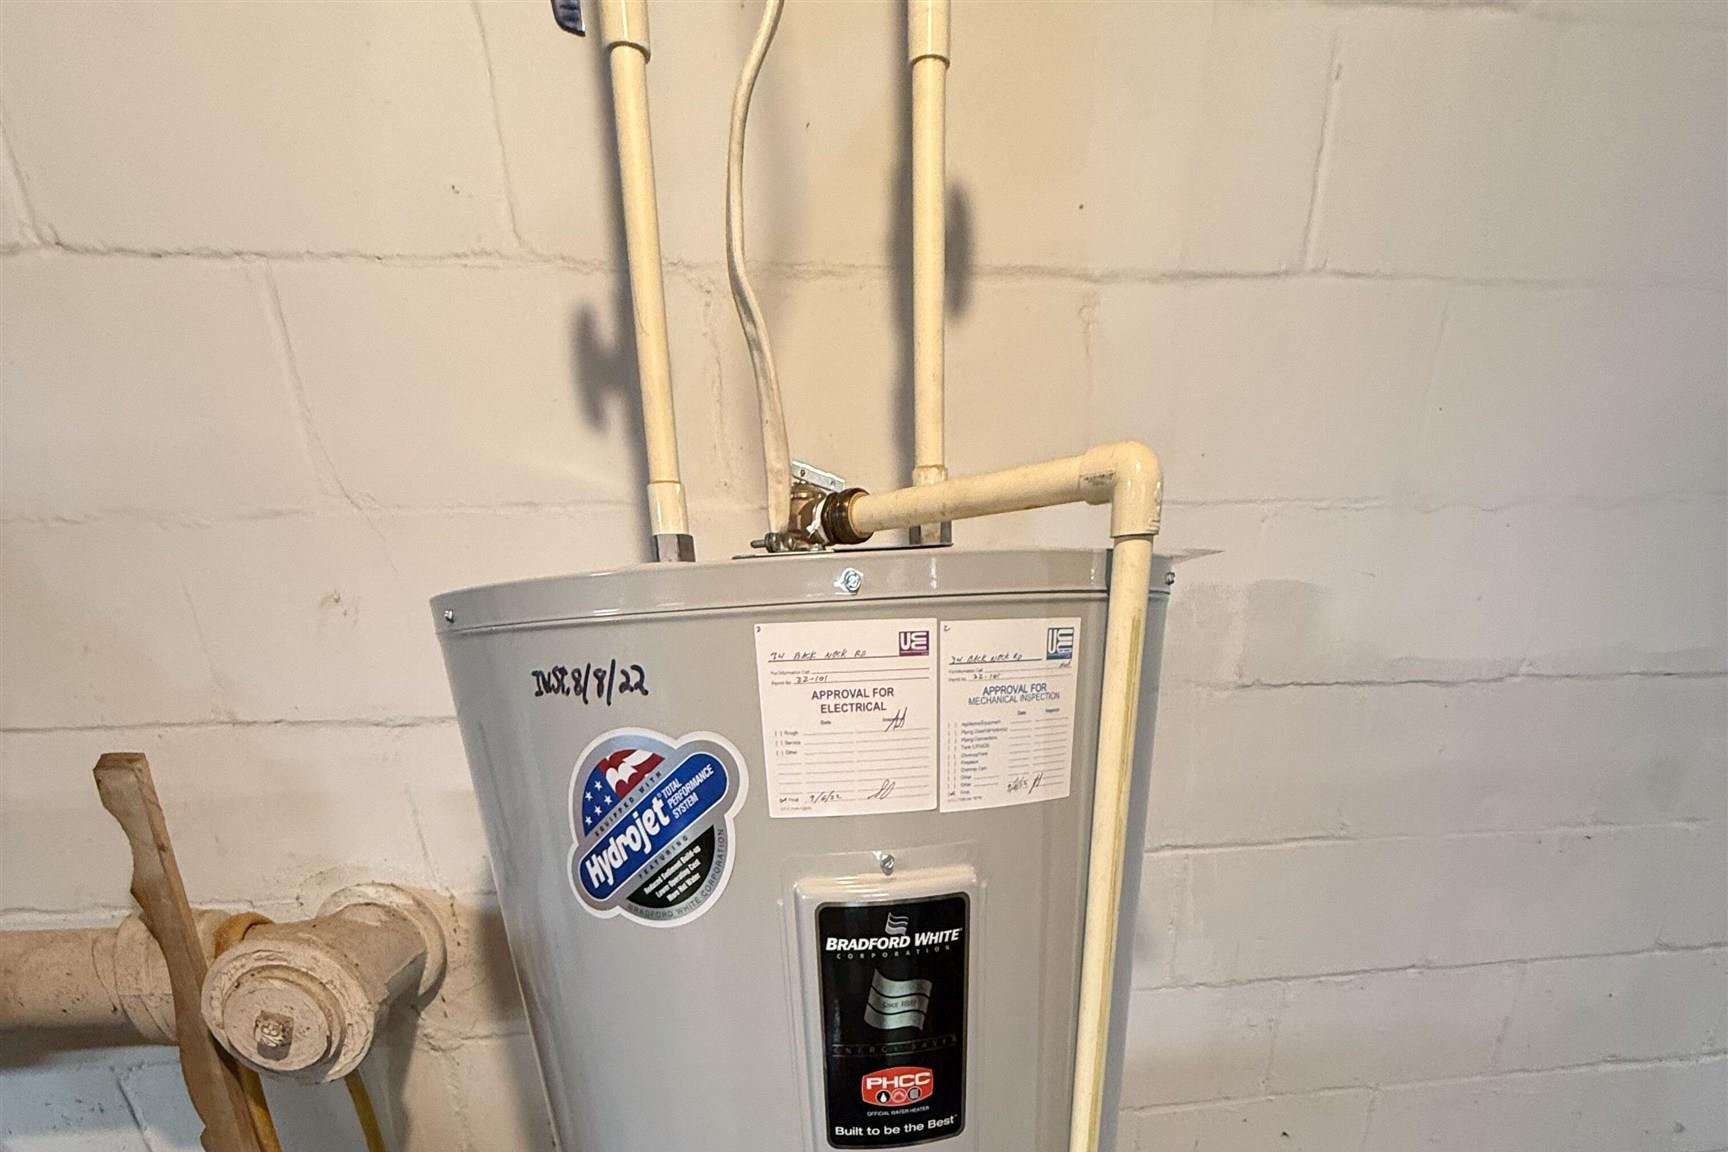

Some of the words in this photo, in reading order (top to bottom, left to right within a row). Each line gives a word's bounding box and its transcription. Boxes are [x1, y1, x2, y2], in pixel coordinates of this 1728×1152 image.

[811, 688, 870, 700] APPROVAL
[873, 686, 895, 698] FOR
[968, 694, 1017, 706] MECHANICAL
[1019, 691, 1060, 703] INSPECTION
[983, 684, 1028, 697] APPROVAL
[1031, 682, 1047, 694] FOR
[820, 701, 888, 714] ELECTRICAL
[662, 778, 682, 799] TOTAL
[667, 763, 715, 808] PERFORMANCE
[594, 798, 635, 837] EQUIPPED
[638, 771, 663, 794] WITH
[672, 793, 699, 820] SYSTEM
[585, 796, 670, 889] Hydrojet
[637, 834, 689, 880] FEATURING
[676, 897, 702, 917] WHITE
[700, 828, 725, 898] CORPORATION
[825, 935, 911, 952] BRADFORD
[914, 928, 960, 947] WHITE
[836, 945, 951, 961] CORPORATION
[866, 1071, 931, 1090] PHCC
[890, 1108, 909, 1116] WATER
[909, 1106, 930, 1114] HEATER
[835, 1126, 864, 1137] Built
[866, 1125, 881, 1136] to
[884, 1124, 901, 1135] be
[904, 1120, 925, 1132] the
[927, 1114, 956, 1130] Best
